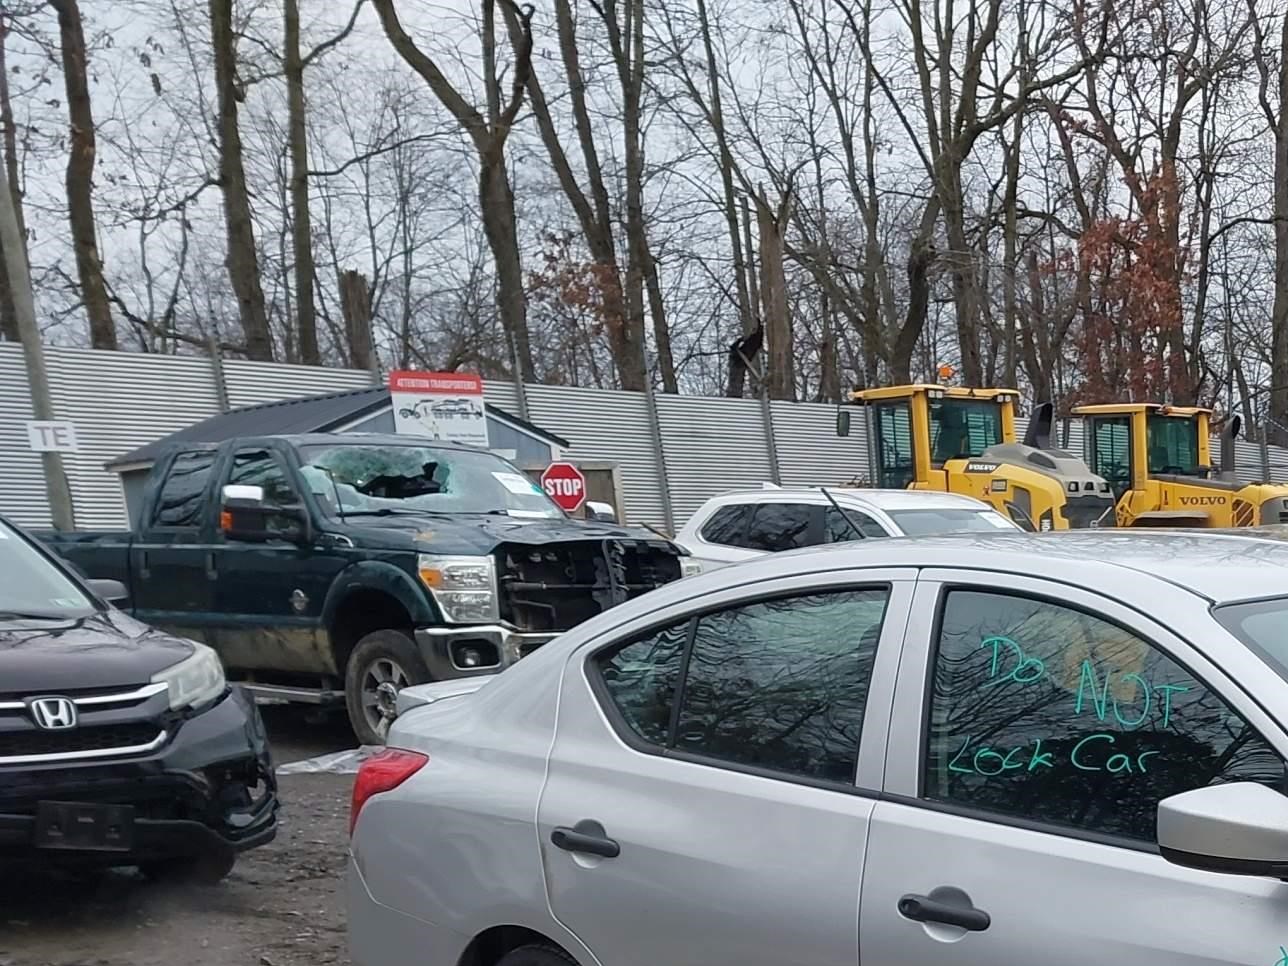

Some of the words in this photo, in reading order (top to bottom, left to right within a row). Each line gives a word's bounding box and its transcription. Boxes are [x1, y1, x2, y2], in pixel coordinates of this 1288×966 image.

[32, 426, 70, 447] TE
[545, 478, 581, 496] STOP
[1179, 496, 1226, 506] VOLVO
[981, 636, 1044, 688] Do
[1075, 660, 1191, 728] NOT
[1071, 734, 1160, 774] Car
